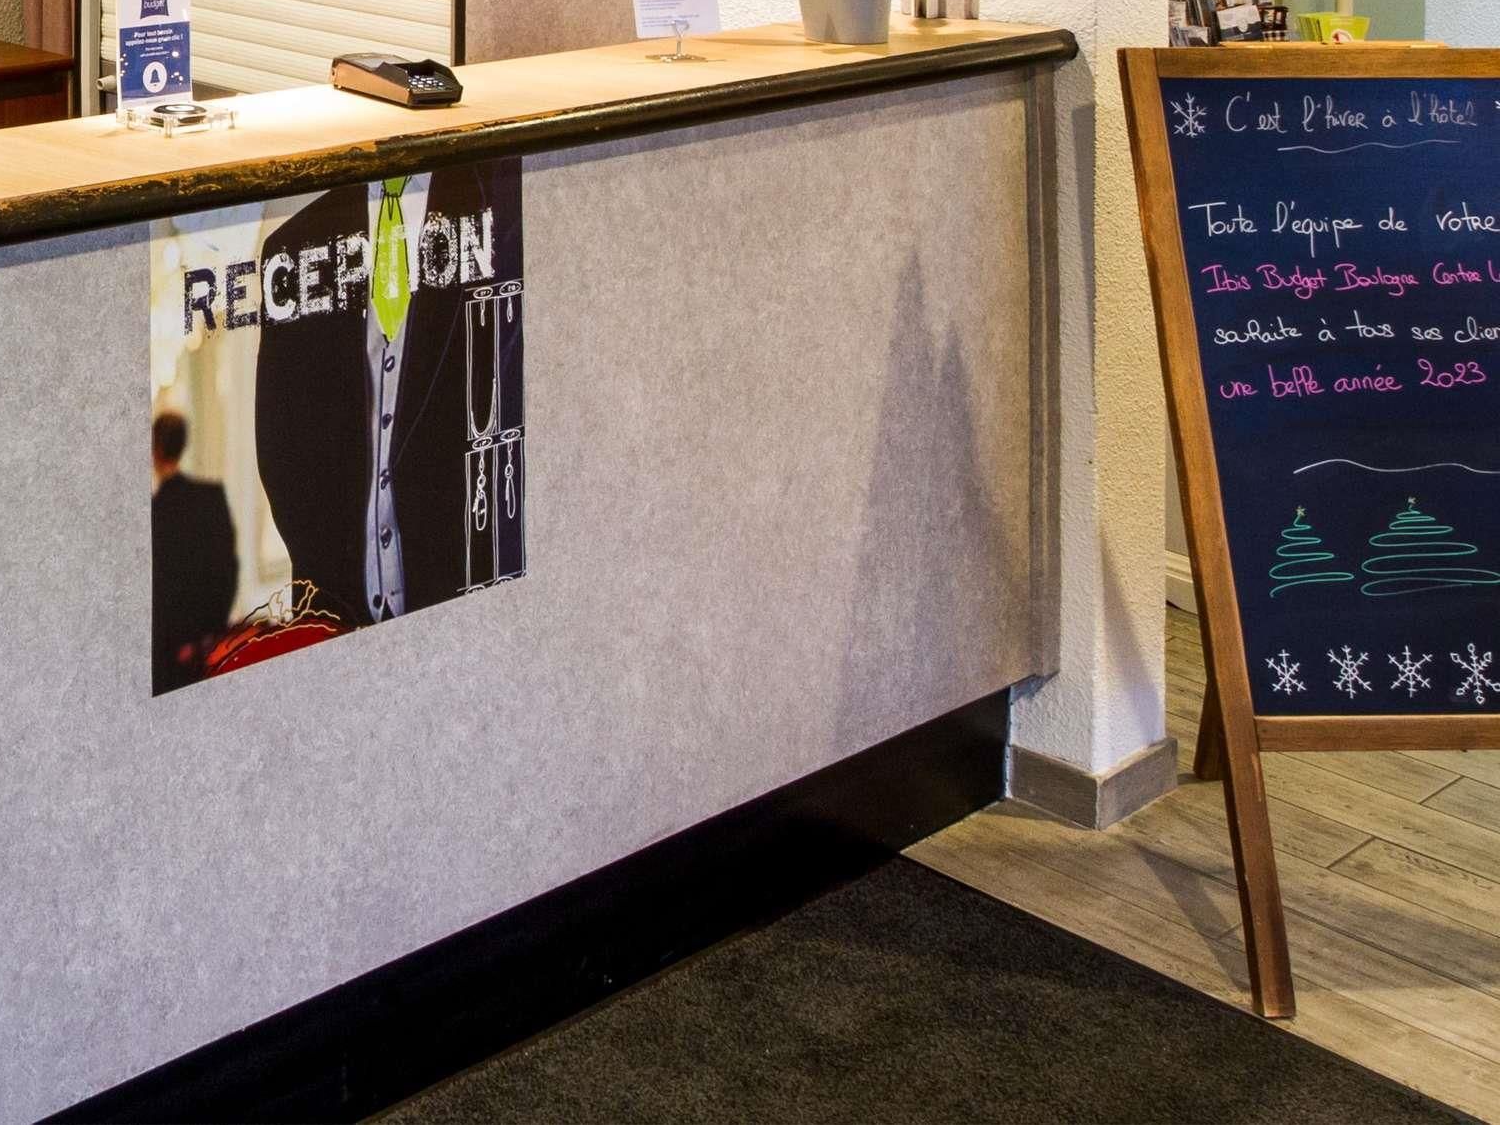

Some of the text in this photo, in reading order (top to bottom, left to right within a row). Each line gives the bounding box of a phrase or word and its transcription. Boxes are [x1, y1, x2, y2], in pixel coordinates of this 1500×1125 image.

[143, 0, 165, 10] budget
[1226, 91, 1478, 132] C'est l'hiver à l'hôtel
[1188, 201, 1258, 237] Toute
[1378, 206, 1408, 232] de
[1435, 201, 1500, 233] votre
[183, 207, 496, 337] RECEPTION
[1201, 263, 1252, 293] Ibis
[1256, 264, 1328, 299] Budget
[1333, 263, 1419, 296] Boulogne
[1432, 262, 1483, 285] Centre
[1213, 316, 1303, 345] souhaite
[1317, 317, 1337, 342] à
[1345, 309, 1396, 339] tous
[1410, 325, 1445, 341] ses
[1219, 358, 1488, 399] une belle année 2023
